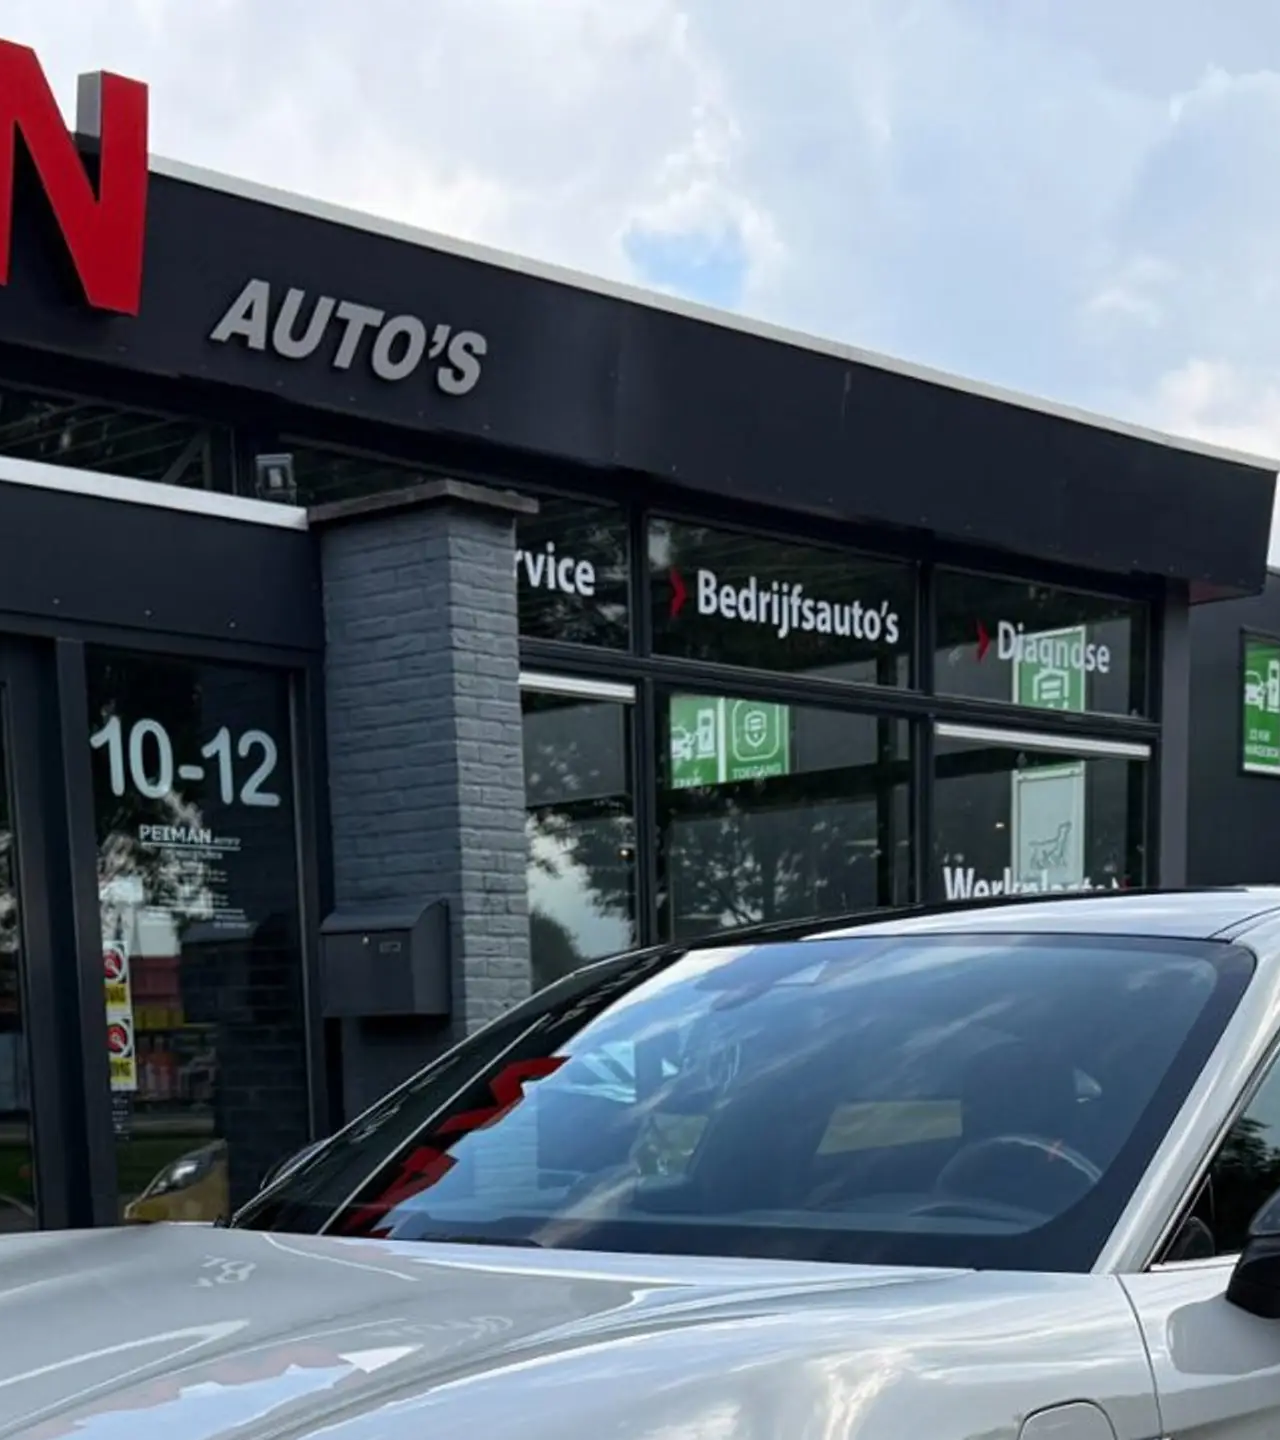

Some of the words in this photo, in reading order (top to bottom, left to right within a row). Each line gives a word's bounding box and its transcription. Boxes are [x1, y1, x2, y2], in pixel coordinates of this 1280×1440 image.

[209, 278, 488, 396] AUTO'S
[697, 569, 899, 643] Bedrijfsauto's
[998, 620, 1110, 673] Diagnose
[90, 715, 281, 807] 10-12
[139, 824, 212, 844] PEIMAN
